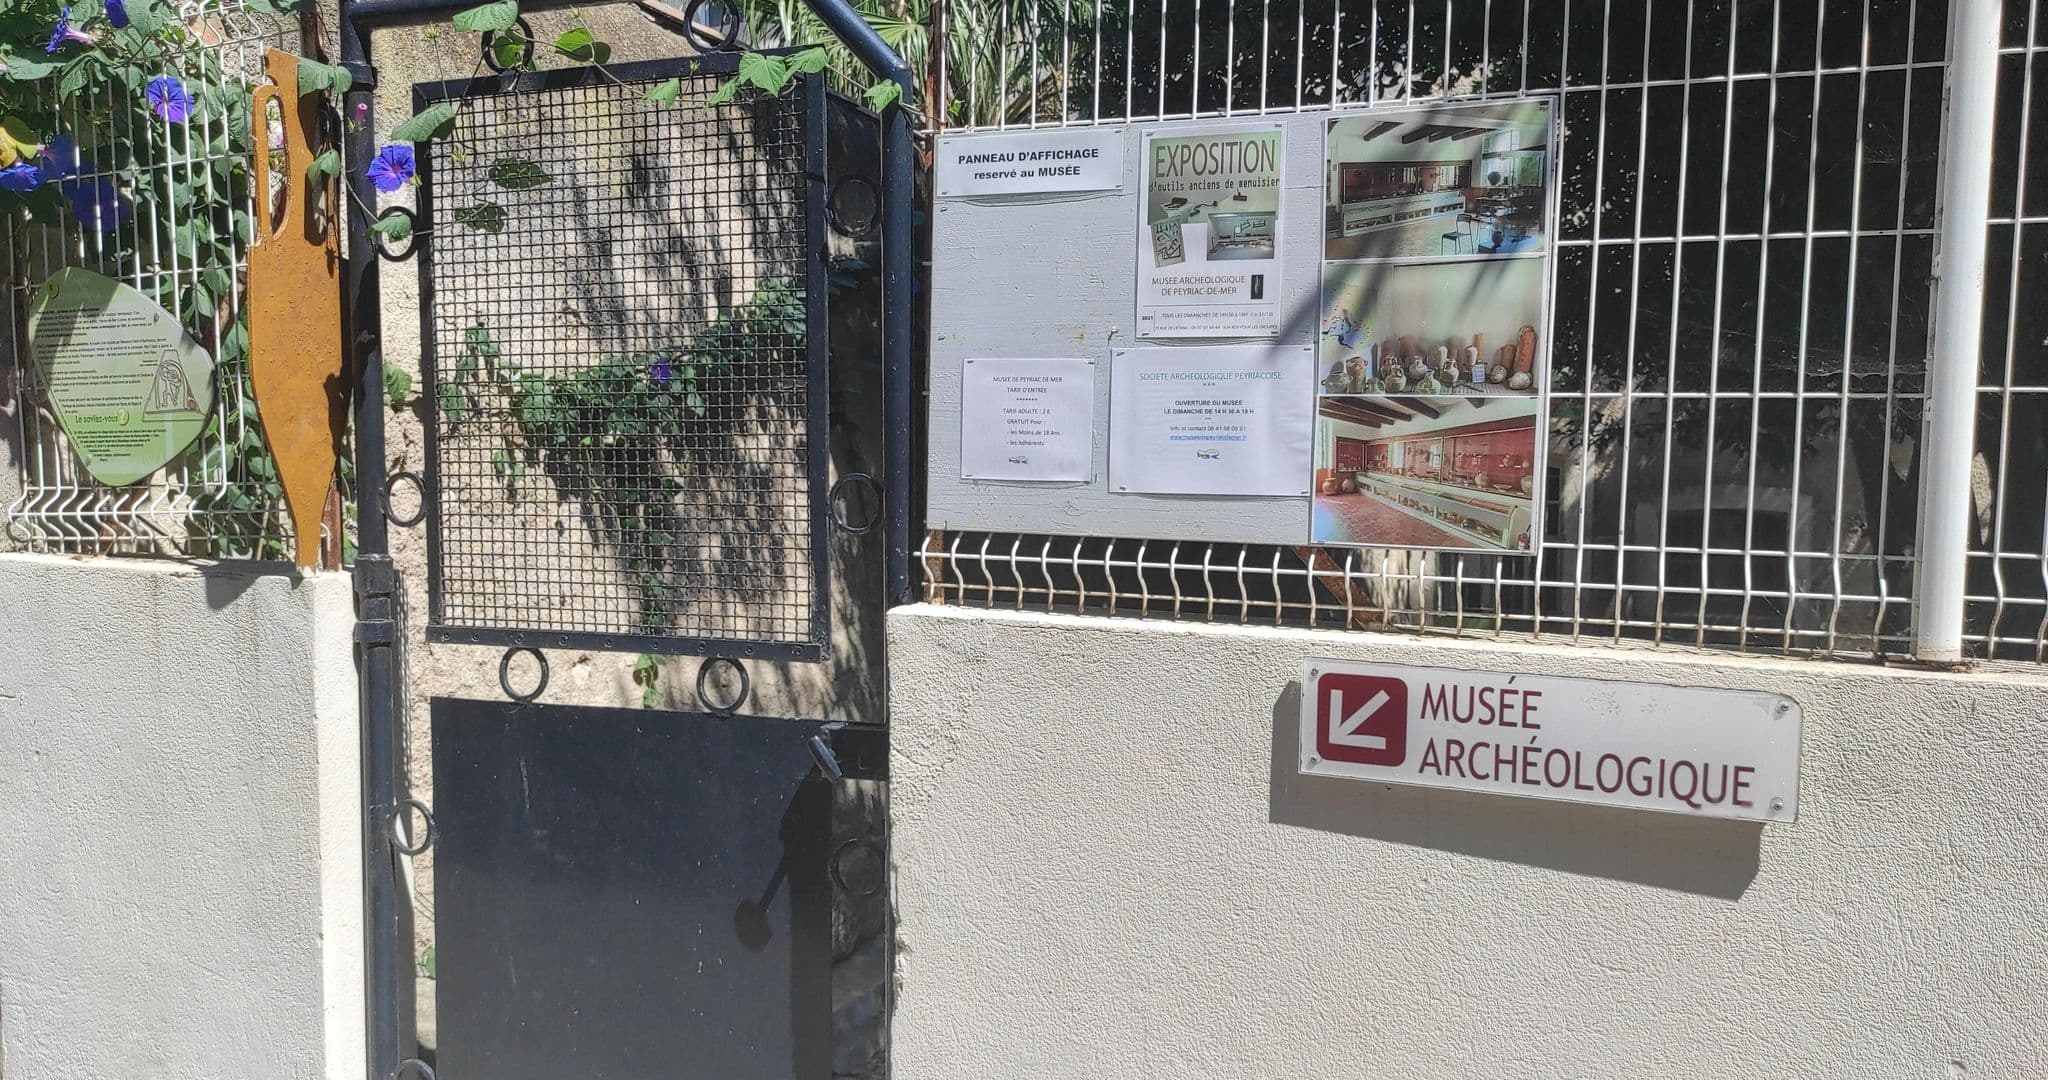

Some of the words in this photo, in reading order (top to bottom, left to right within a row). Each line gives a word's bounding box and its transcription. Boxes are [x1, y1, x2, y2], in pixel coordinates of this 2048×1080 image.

[958, 153, 1015, 165] PANNEAU
[1018, 148, 1099, 161] D'AFFICHAGE
[1155, 139, 1275, 178] EXPOSITION
[974, 168, 1017, 180] reservé
[1020, 169, 1035, 179] au
[1038, 164, 1081, 177] MUSÉE
[1189, 180, 1220, 190] anciens
[1225, 178, 1234, 189] de
[1239, 176, 1280, 188] menuisier
[1151, 277, 1177, 285] MUSEE
[1180, 275, 1246, 285] ARCHEOLOGIQUE
[1161, 287, 1172, 296] DE
[1170, 372, 1233, 380] ARCHEOLOGIQUE
[1234, 371, 1282, 380] PEYRIACOISE
[75, 415, 83, 423] Le
[1420, 675, 1543, 730] MUSÉE
[1418, 735, 1756, 810] ARCHÉOLOGIQUE
